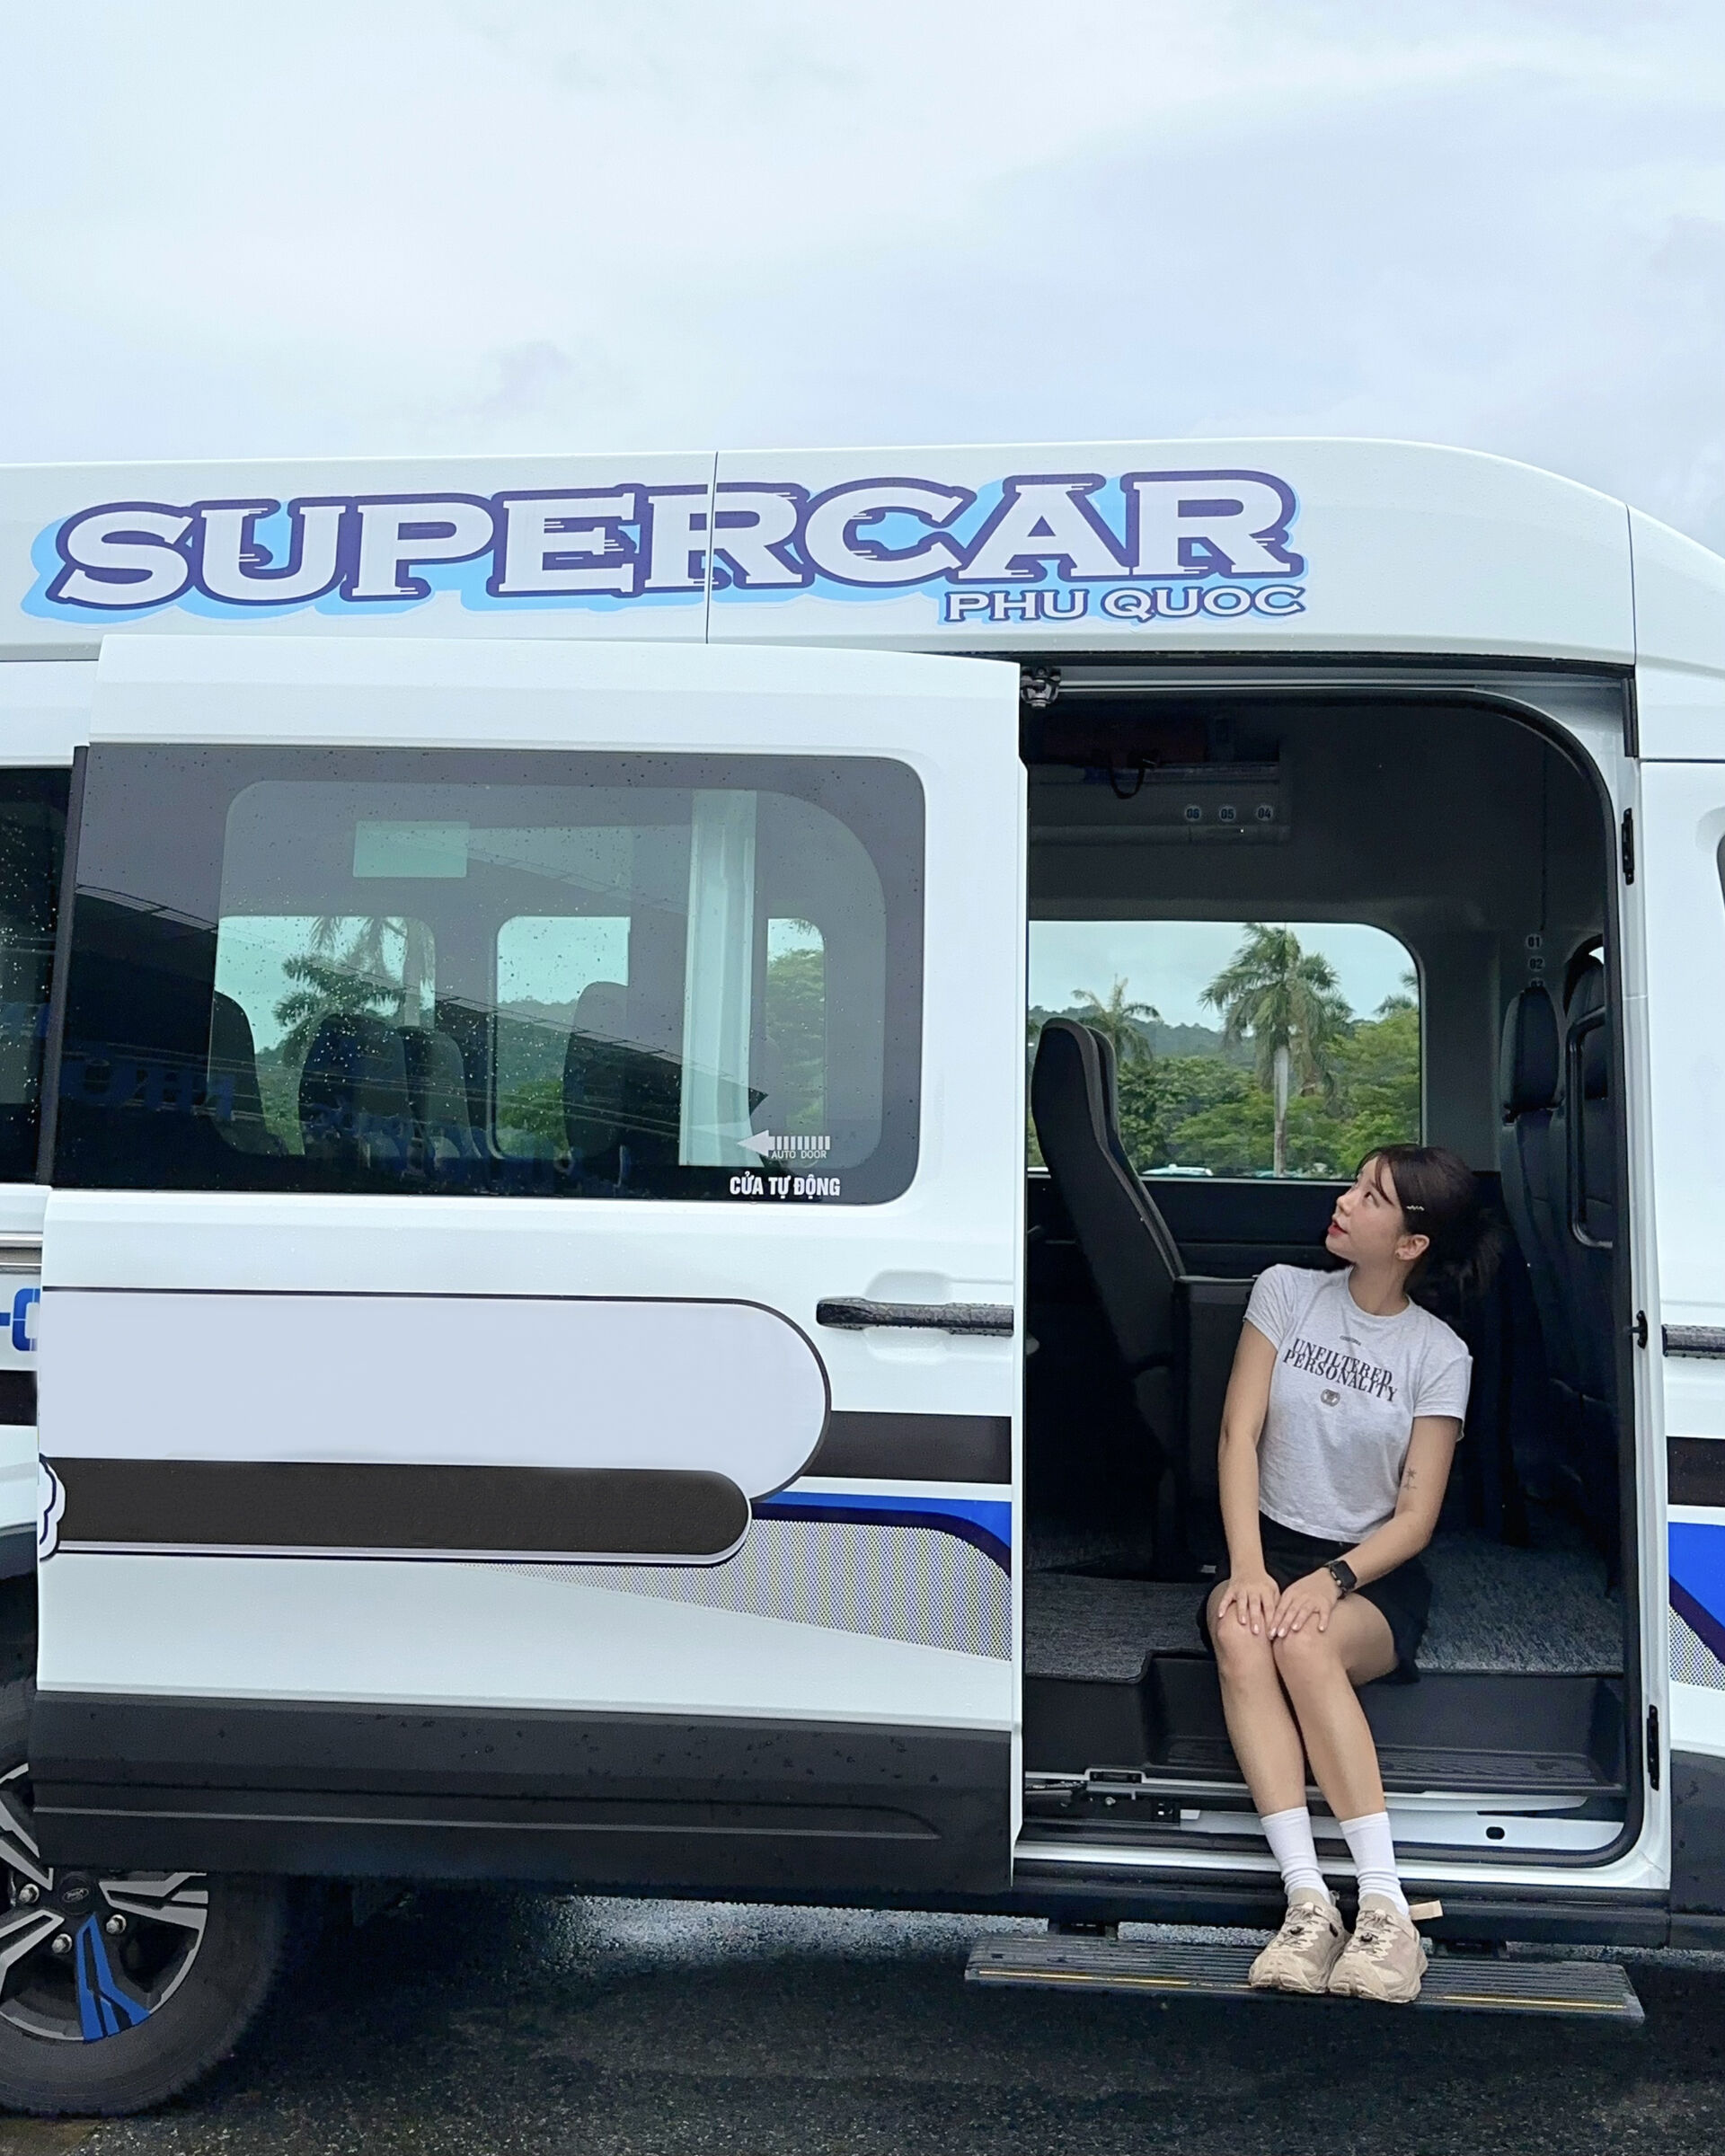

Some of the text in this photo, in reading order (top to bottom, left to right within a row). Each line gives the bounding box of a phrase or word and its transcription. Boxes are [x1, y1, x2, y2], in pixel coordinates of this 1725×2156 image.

[45, 469, 1307, 611] SUPERCAR
[945, 584, 1306, 623] PHU QUOC
[1220, 808, 1234, 819] 05
[1258, 807, 1271, 819] 04
[772, 1151, 827, 1159] AUTO DOOR
[730, 1171, 841, 1199] CỬA TỰ ĐỘNG
[1282, 1348, 1398, 1401] PERSONALITY
[1292, 1338, 1393, 1385] UNFILTERED
